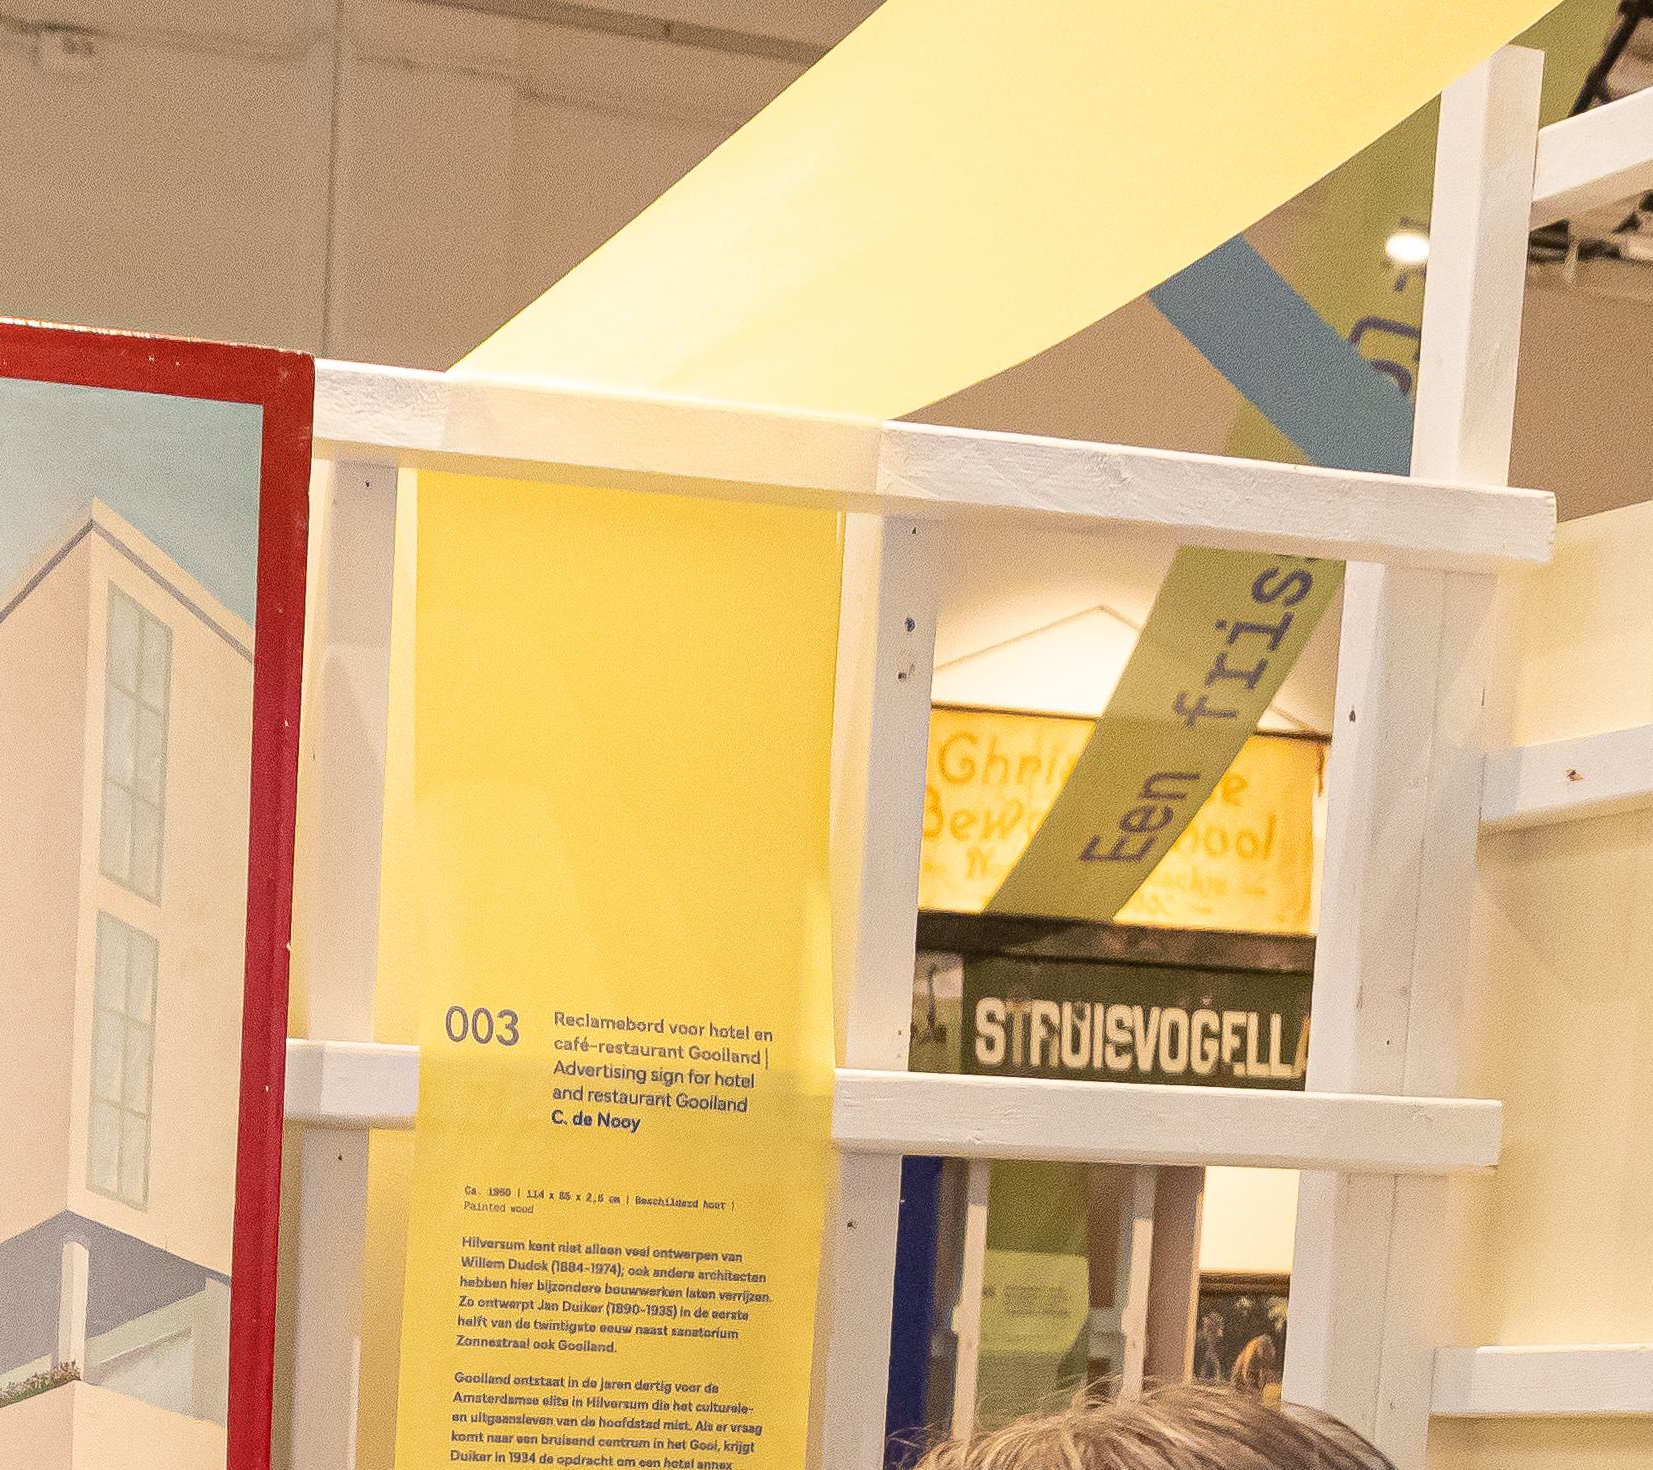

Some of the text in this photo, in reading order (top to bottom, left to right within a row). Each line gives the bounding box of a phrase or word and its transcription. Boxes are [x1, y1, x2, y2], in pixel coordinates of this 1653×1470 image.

[1079, 768, 1202, 866] Een
[1172, 554, 1317, 728] fris
[446, 1005, 521, 1046] 003
[553, 1011, 774, 1043] Reclamebord voor hotel en
[553, 1036, 684, 1060] café-restaurant
[688, 1045, 762, 1066] Gooiland
[553, 1060, 755, 1089] Advertising sign for hotel
[552, 1085, 749, 1113] and restaurant Gooiland
[550, 1108, 641, 1134] C. de Nooy
